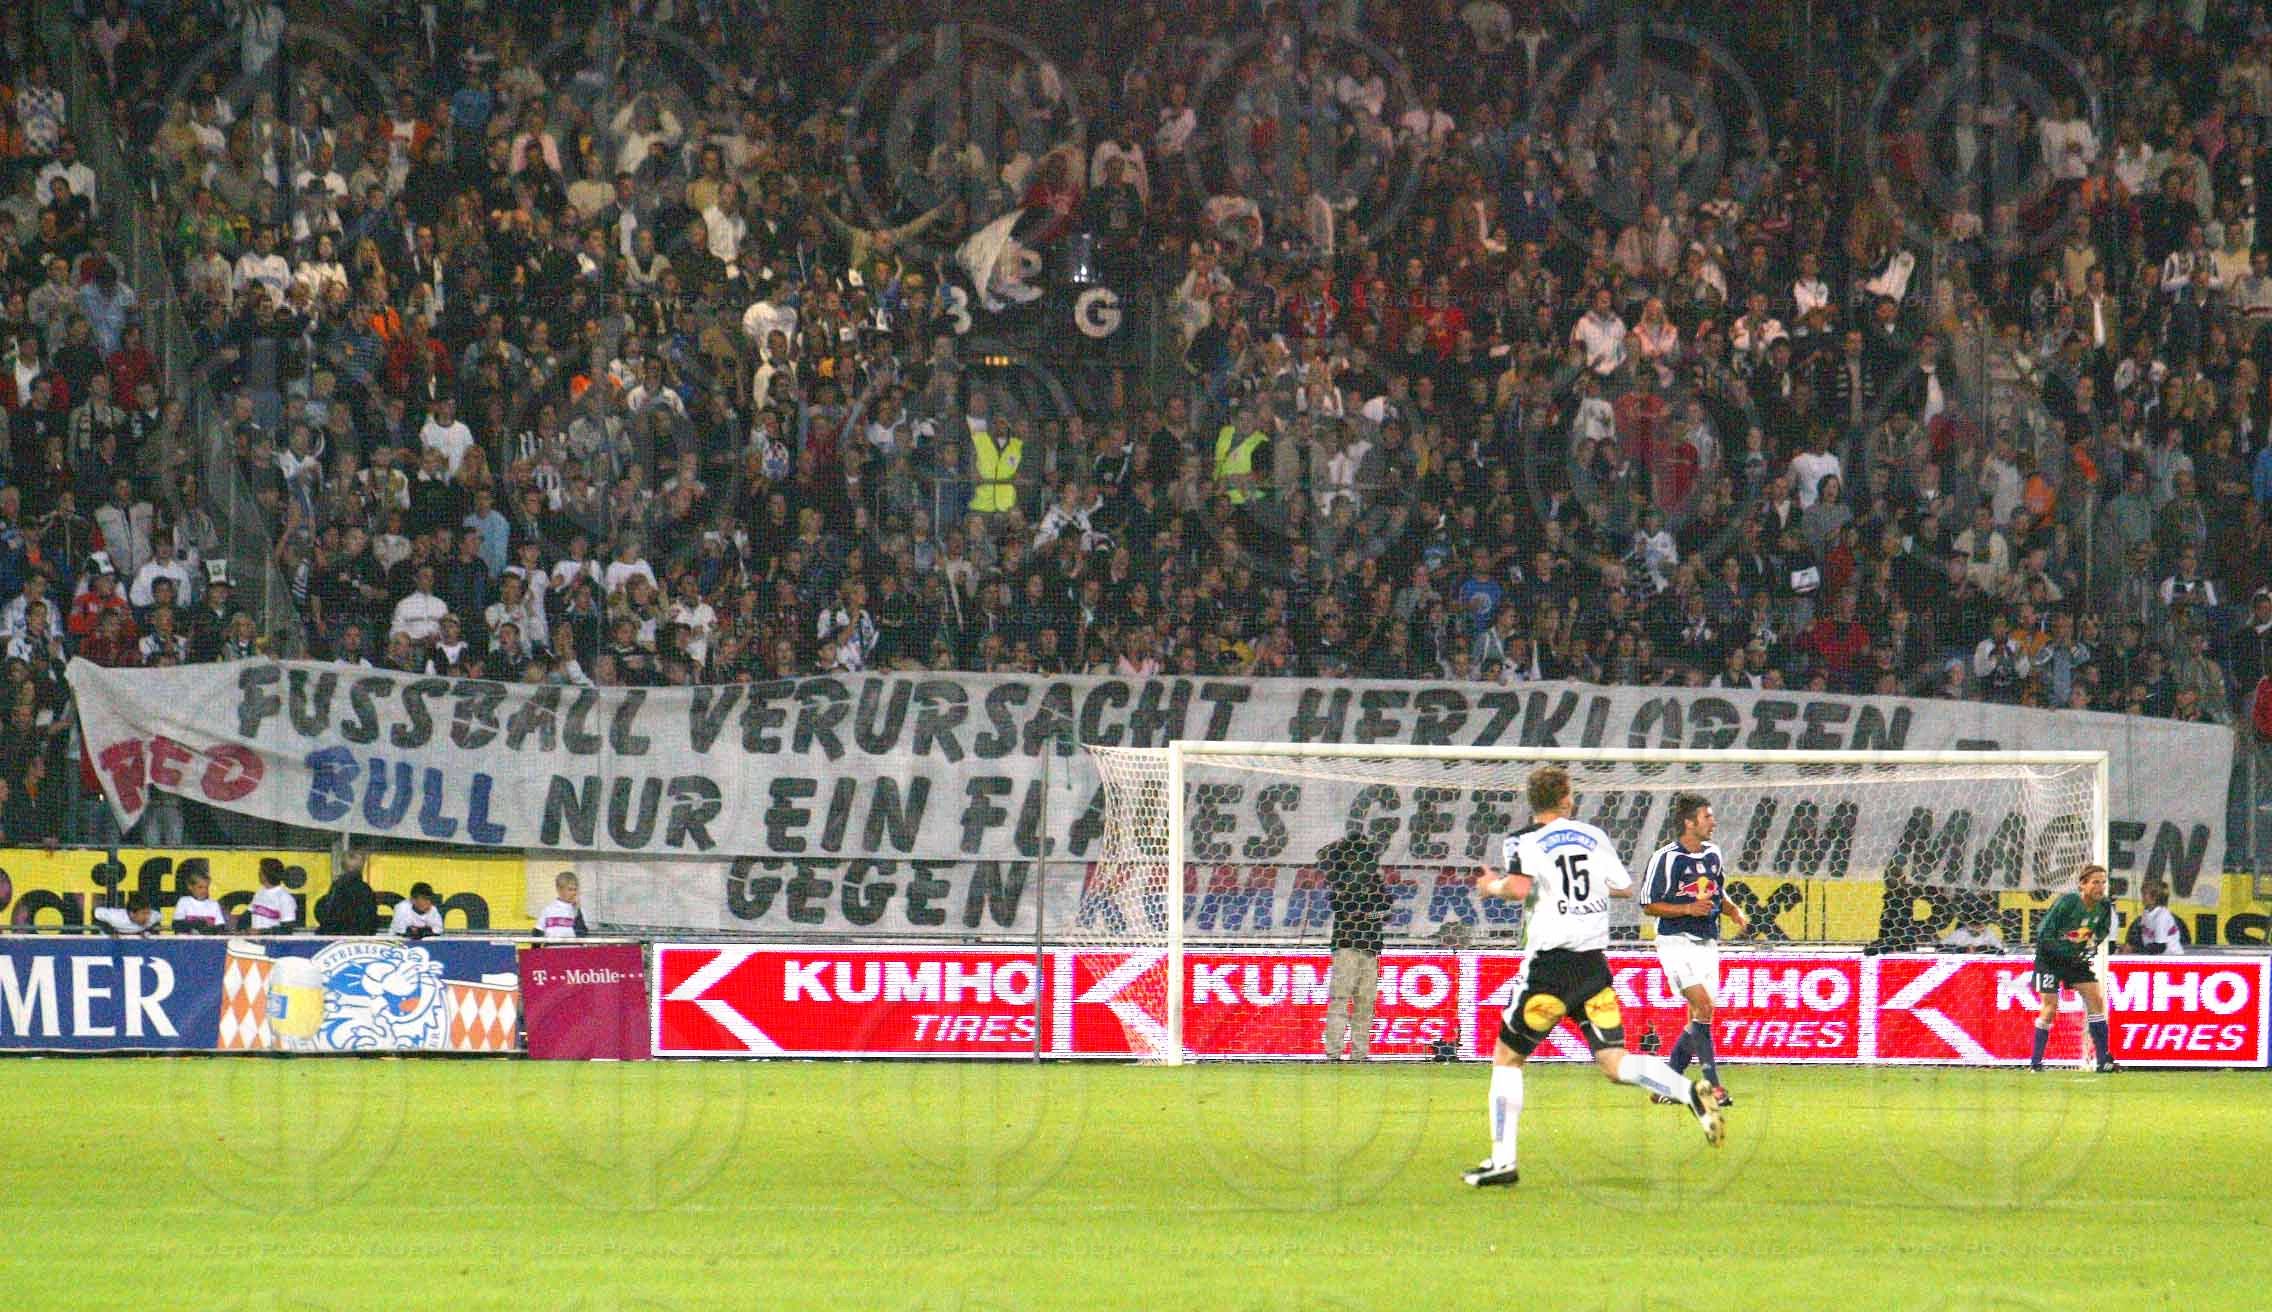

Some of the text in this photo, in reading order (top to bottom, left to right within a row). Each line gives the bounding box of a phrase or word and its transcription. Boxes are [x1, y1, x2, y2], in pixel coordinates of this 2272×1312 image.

[1074, 287, 1122, 339] G
[238, 664, 652, 756] FUSSBALL
[688, 678, 1252, 764] VERURSACHT
[304, 745, 506, 845] BULL
[539, 774, 722, 852] NUR
[764, 776, 932, 854] EIN
[1346, 783, 1693, 866] GEFH
[1737, 796, 1859, 879] IM
[726, 859, 1031, 929] GEGEN
[1555, 854, 1590, 902] 15
[0, 955, 180, 1037] MER
[784, 960, 1039, 1005] KUMHO
[1996, 969, 2249, 1015] KMHO
[2043, 973, 2055, 988] 22
[911, 1014, 1038, 1042] TIRES
[1720, 1020, 1847, 1048] TIRES
[2119, 1023, 2248, 1051] TIRES
